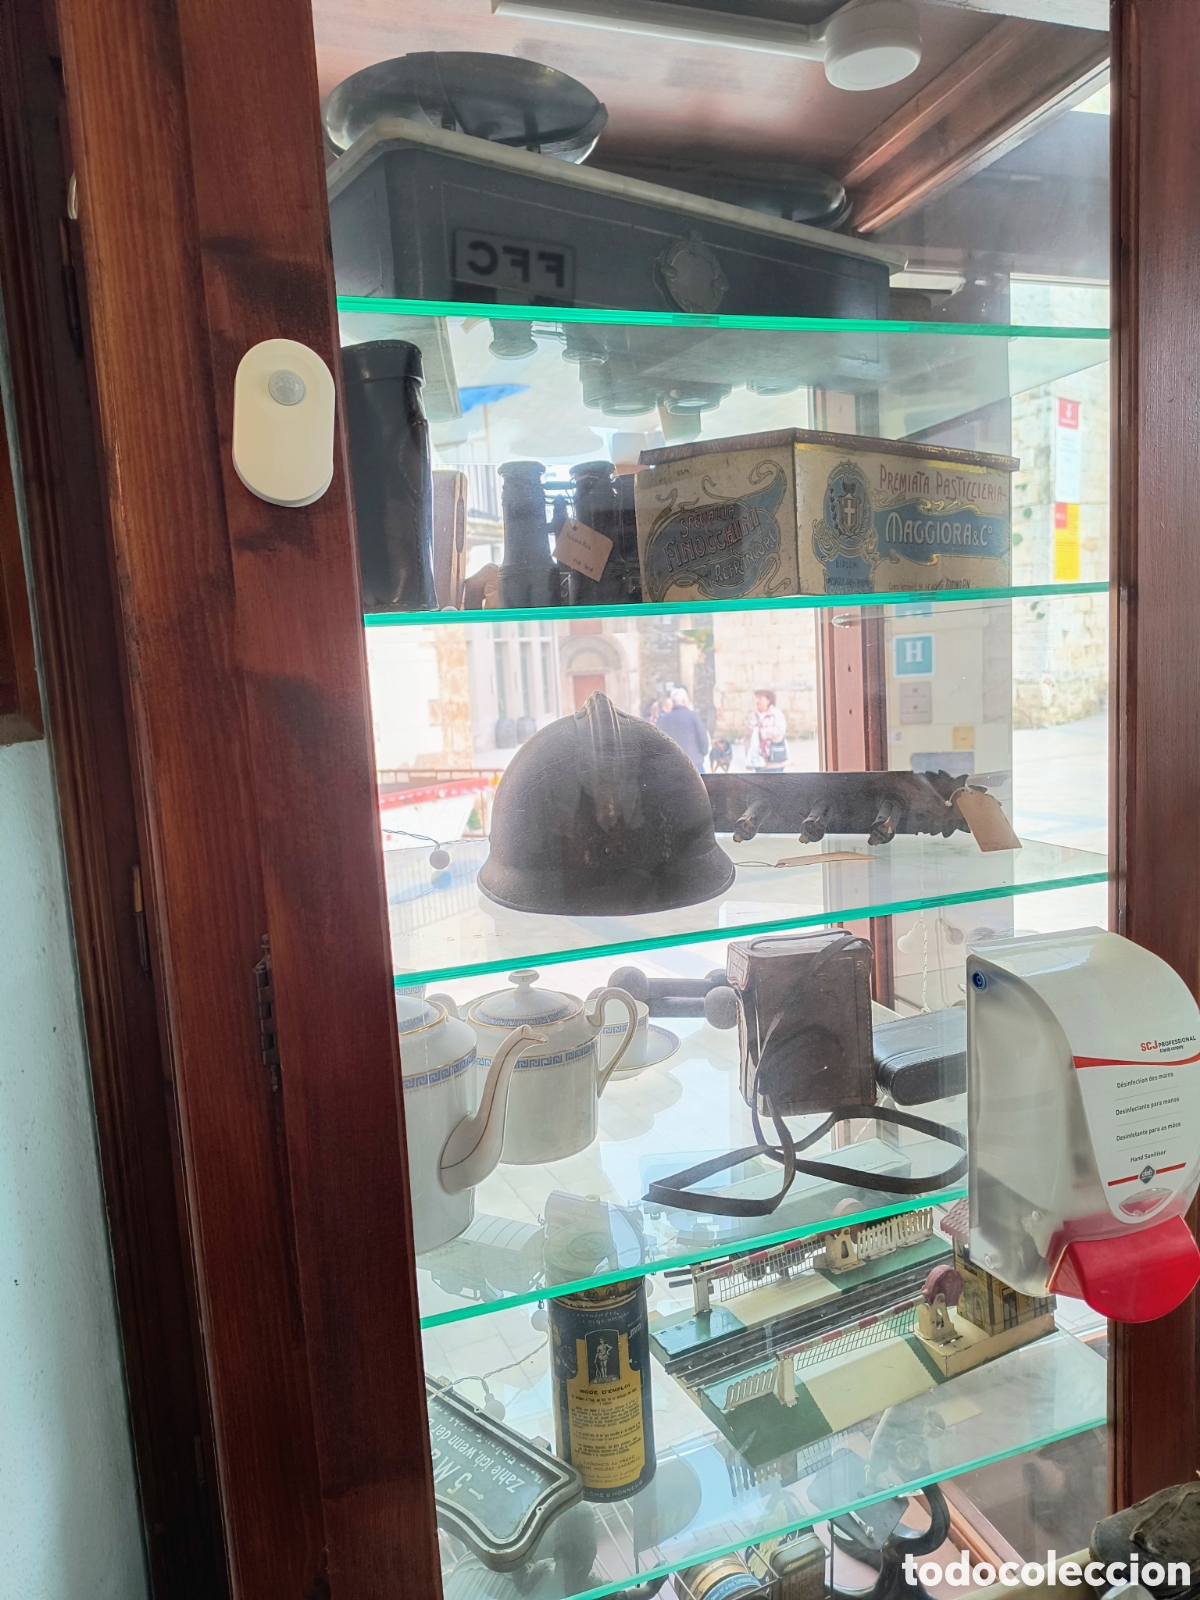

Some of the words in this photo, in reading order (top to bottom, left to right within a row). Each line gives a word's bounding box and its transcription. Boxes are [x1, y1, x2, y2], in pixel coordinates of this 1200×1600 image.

[879, 463, 930, 494] PREMIATA
[936, 471, 1006, 502] PASTICCIERIA
[663, 509, 760, 572] FINOCCHINI
[904, 640, 924, 663] H
[1140, 1040, 1158, 1052] SCJ
[1158, 1036, 1196, 1048] PROFESSIONAL
[1116, 1077, 1149, 1089] Désinfection
[1158, 1072, 1174, 1080] mains
[1115, 1103, 1150, 1116] Desinfectante
[1151, 1101, 1162, 1109] para
[1163, 1097, 1180, 1105] manos
[1116, 1130, 1148, 1142] Desinfetante
[1149, 1126, 1160, 1135] para
[1130, 1154, 1144, 1162] Hand
[601, 1383, 632, 1395] D'EMPLOI
[447, 1433, 478, 1460] wenn
[431, 1448, 462, 1485] Ma
[491, 1465, 526, 1494] Zahle
